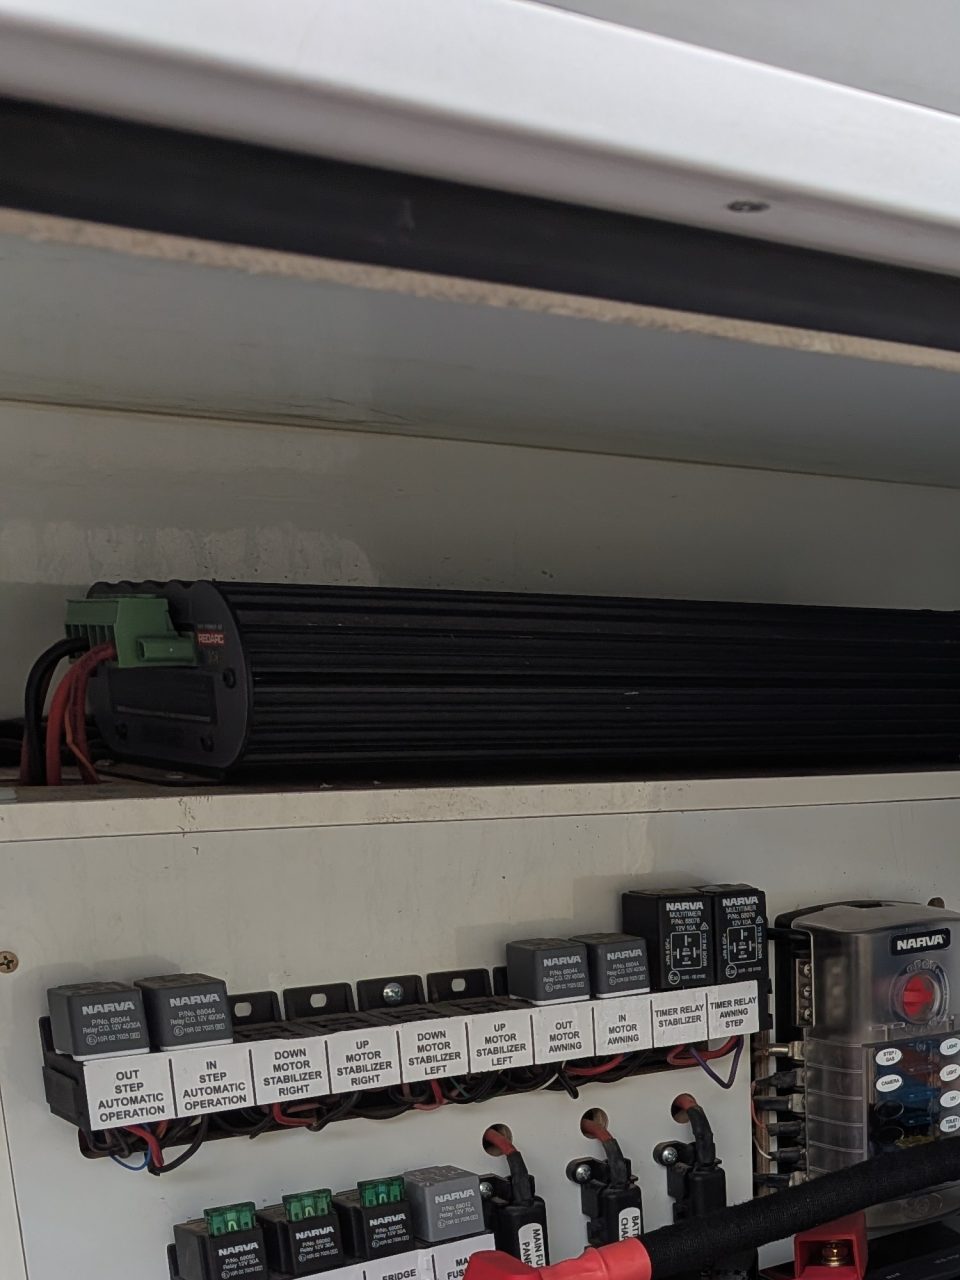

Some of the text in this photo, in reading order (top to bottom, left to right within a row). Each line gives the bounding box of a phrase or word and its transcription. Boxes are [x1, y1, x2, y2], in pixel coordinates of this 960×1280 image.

[666, 901, 704, 911] NARVA
[722, 896, 759, 907] NARVA
[897, 932, 944, 951] NARVA
[607, 949, 642, 960] NARVA
[543, 955, 581, 967] NARVA
[169, 993, 221, 1007] NARVA
[710, 997, 757, 1010] TIMER RELAY
[82, 1001, 135, 1015] NARVA
[655, 1004, 704, 1018] TIMER RELAY
[719, 1007, 749, 1020] AWNING
[618, 1014, 626, 1023] IN
[658, 1015, 702, 1028] STABILIZER
[725, 1019, 744, 1029] STEP
[82, 1026, 98, 1034] Relay
[493, 1023, 506, 1032] UP
[555, 1021, 573, 1031] OUT
[608, 1024, 638, 1035] MOTOR
[417, 1030, 446, 1042] DOWN
[485, 1033, 516, 1045] MOTOR
[549, 1031, 580, 1042] MOTOR
[607, 1033, 640, 1046] AWNING
[356, 1040, 369, 1050] UP
[417, 1041, 451, 1053] MOTOR
[476, 1043, 526, 1057] STABILIZER
[548, 1041, 582, 1053] AWNING
[274, 1048, 306, 1060] DOWN
[345, 1050, 381, 1063] MOTOR
[408, 1051, 461, 1066] STABILIZER
[206, 1061, 217, 1070] IN
[273, 1060, 311, 1073] MOTOR
[491, 1056, 513, 1066] LEFT
[337, 1060, 392, 1076] STABILIZER
[424, 1065, 447, 1076] LEFT
[116, 1069, 139, 1081] OUT
[199, 1071, 227, 1083] STEP
[263, 1070, 322, 1086] STABILIZER
[351, 1074, 381, 1086] RIGHT
[881, 1078, 900, 1086] CAMERA
[115, 1082, 144, 1095] STEP
[182, 1082, 246, 1098] AUTOMATIC
[278, 1084, 310, 1096] RIGHT
[98, 1092, 164, 1110] AUTOMATIC
[184, 1094, 247, 1111] OPERATION
[99, 1105, 165, 1123] OPERATION
[435, 1188, 475, 1204] NARVA
[369, 1212, 407, 1227] NARVA
[440, 1211, 453, 1219] Relay
[296, 1226, 334, 1239] NARVA
[218, 1242, 259, 1256] NARVA
